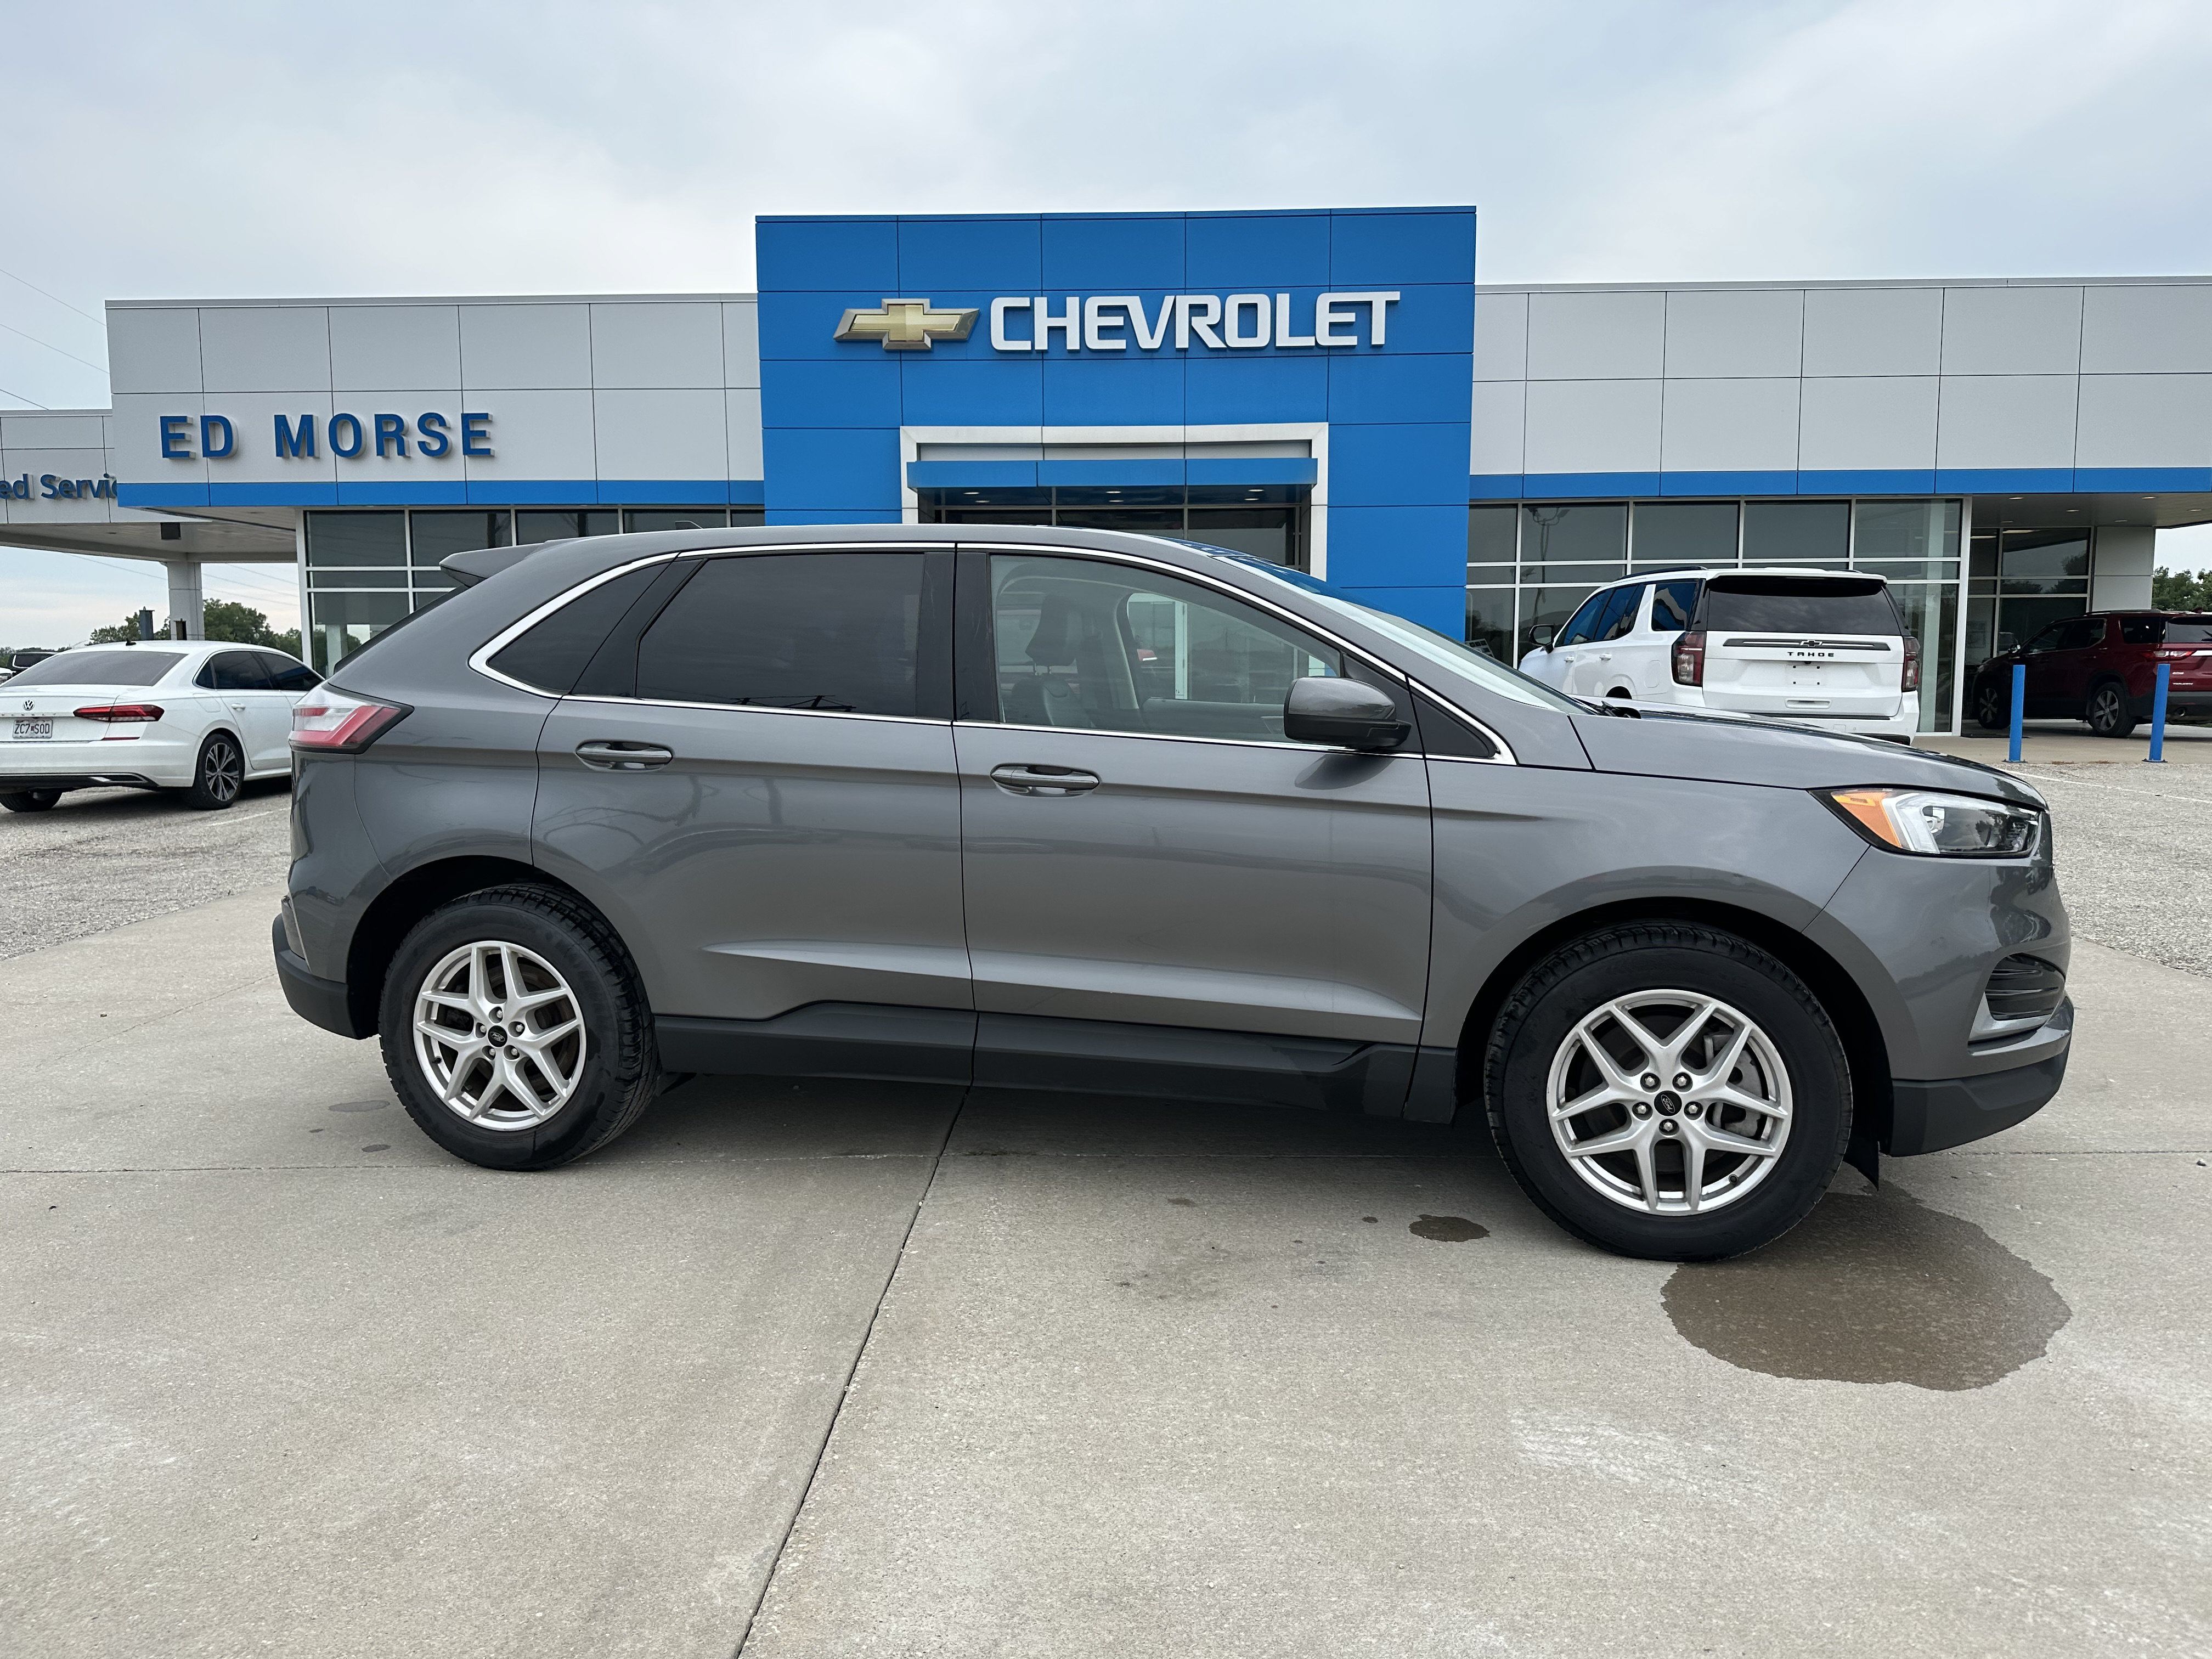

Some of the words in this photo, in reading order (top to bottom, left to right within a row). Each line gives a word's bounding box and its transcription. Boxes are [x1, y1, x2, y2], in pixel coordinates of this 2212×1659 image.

[990, 291, 1400, 351] CHEVROLET
[160, 415, 235, 459] ED
[274, 413, 493, 458] MORSE
[14, 723, 30, 734] ZC7
[1662, 1097, 1674, 1111] Ford
